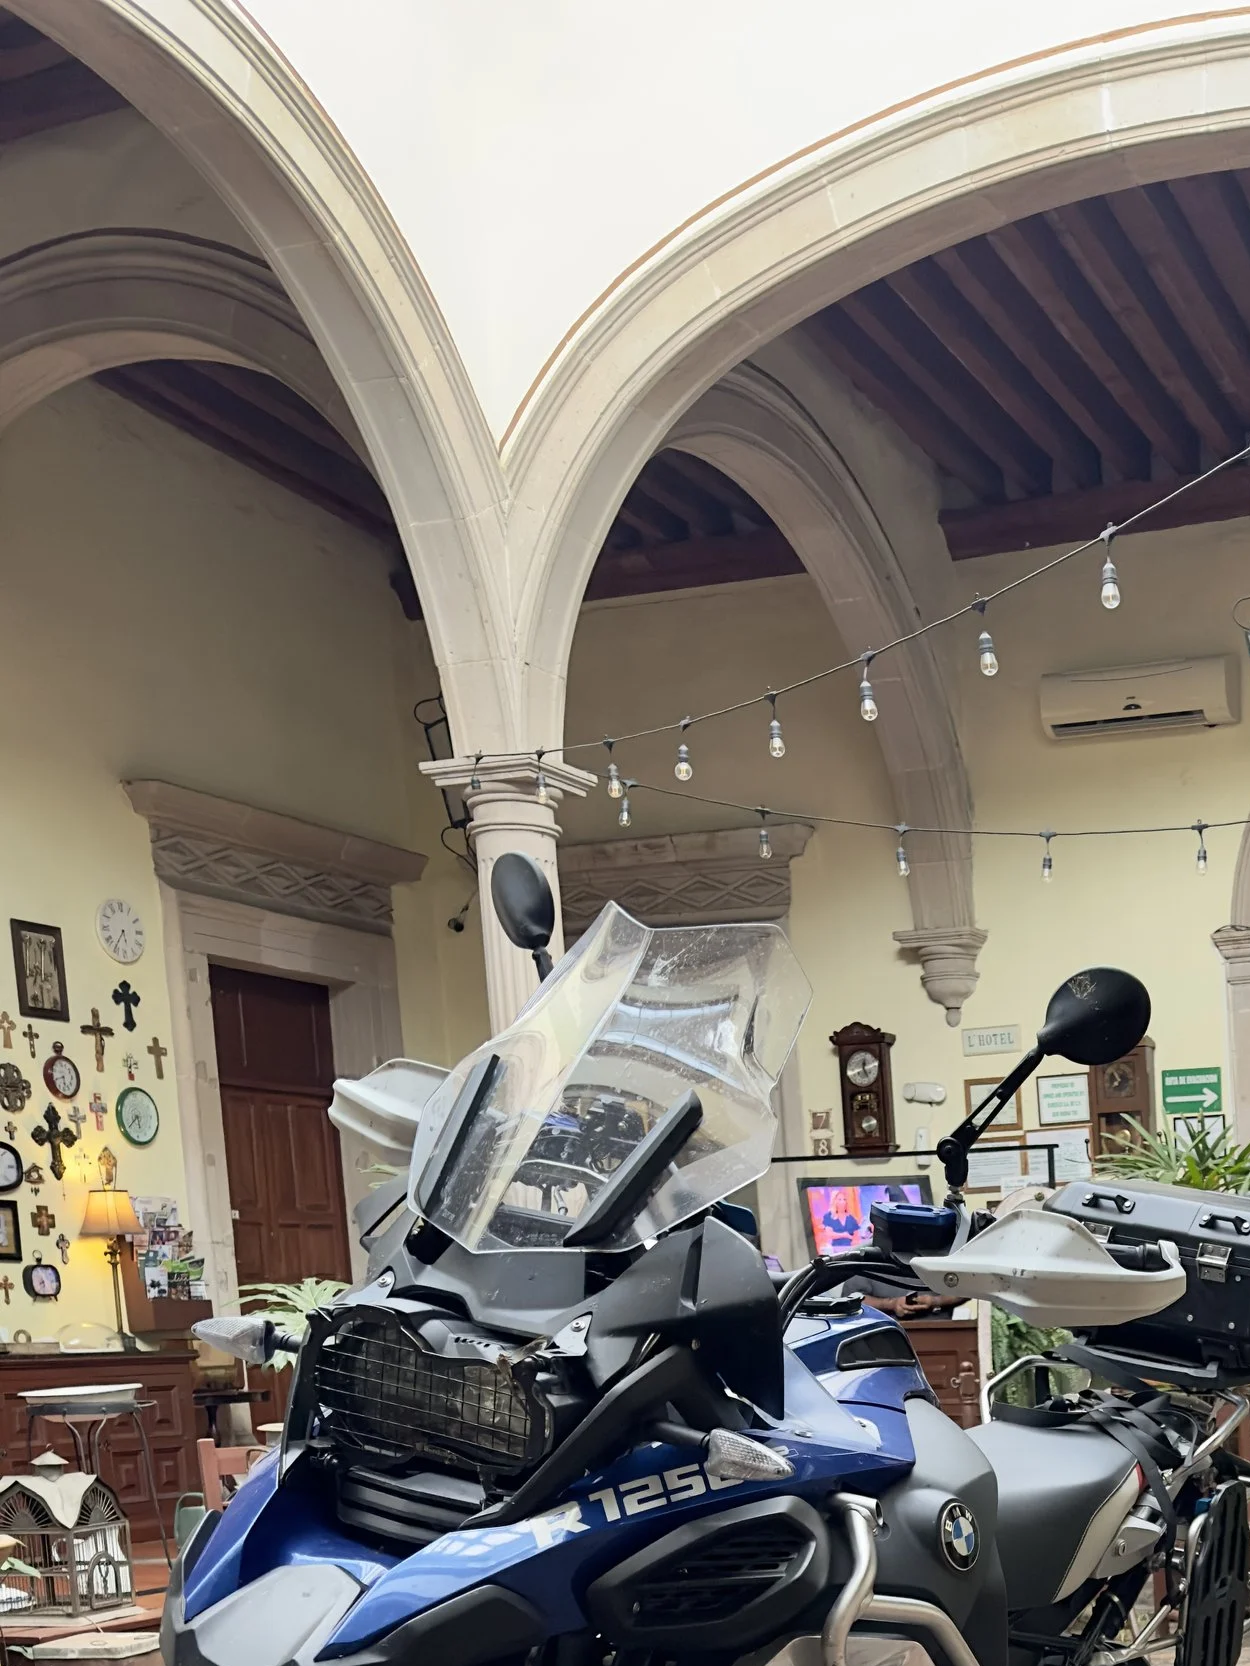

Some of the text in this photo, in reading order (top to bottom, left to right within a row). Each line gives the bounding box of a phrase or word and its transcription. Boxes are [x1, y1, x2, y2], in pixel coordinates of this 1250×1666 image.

[816, 1112, 827, 1130] 7
[818, 1139, 829, 1157] 8
[527, 1500, 591, 1550] R
[944, 1506, 973, 1533] BMW
